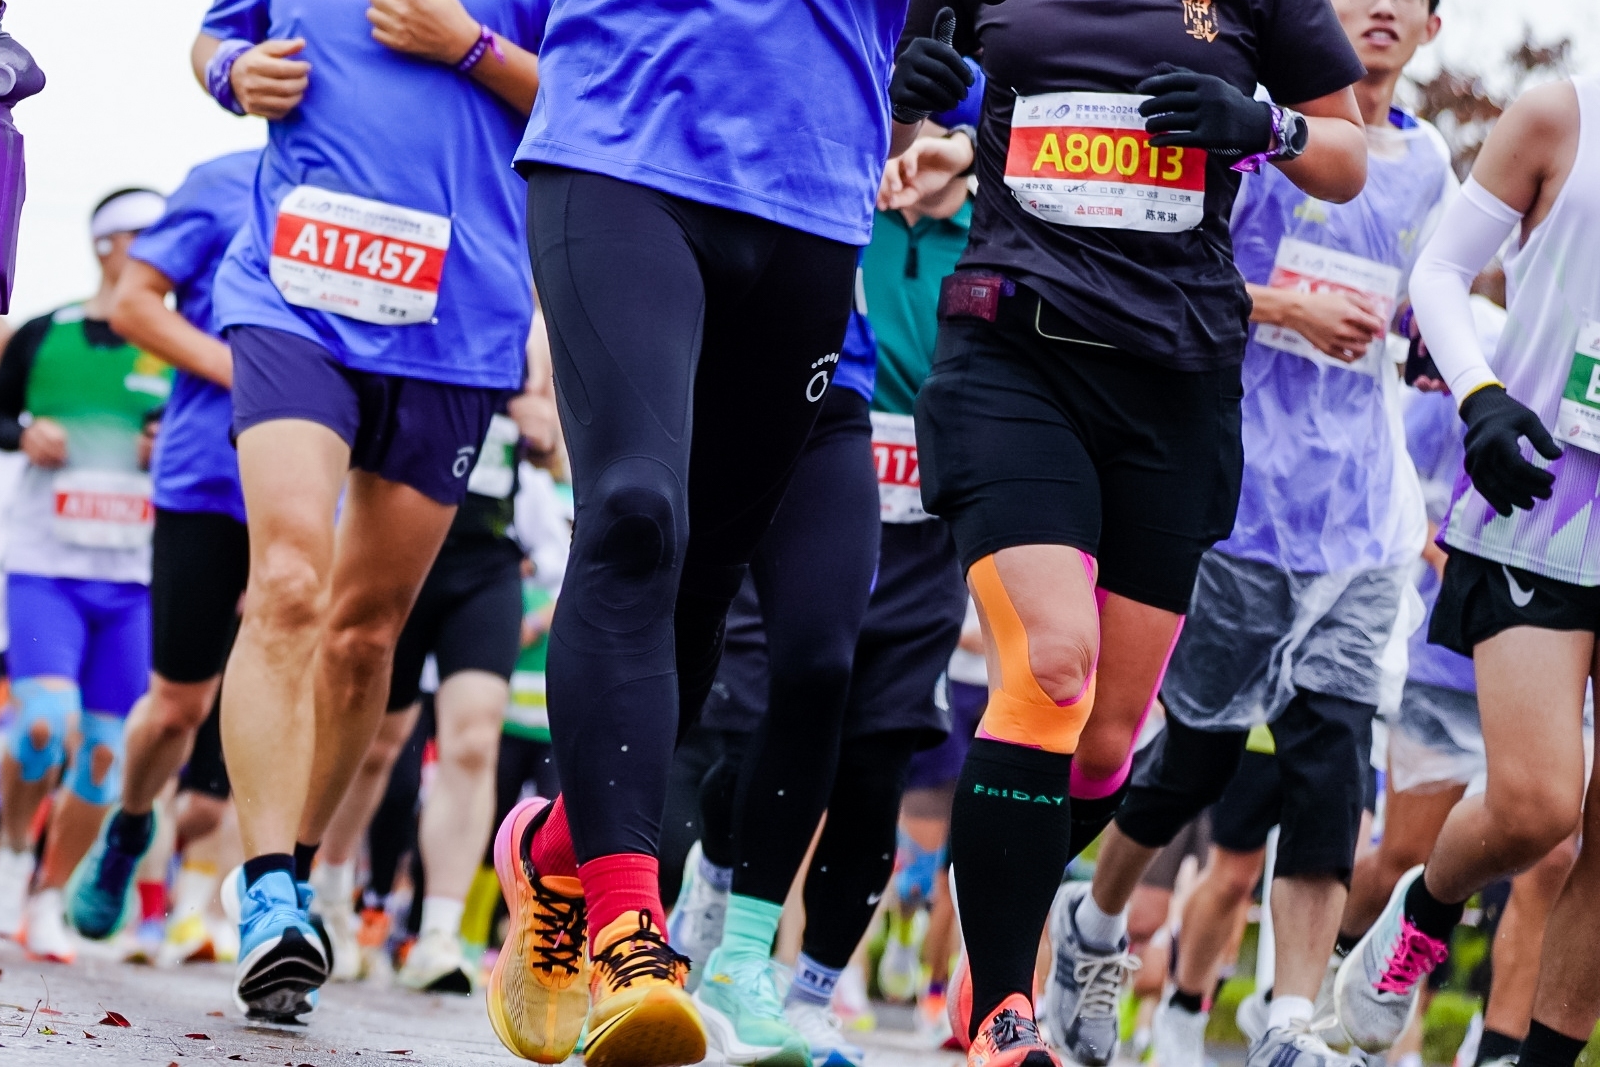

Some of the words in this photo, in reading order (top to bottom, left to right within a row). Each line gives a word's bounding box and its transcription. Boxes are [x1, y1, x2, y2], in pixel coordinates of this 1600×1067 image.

[1032, 133, 1184, 181] A80013
[289, 223, 427, 283] A11457
[974, 784, 1064, 805] FRIDAY
